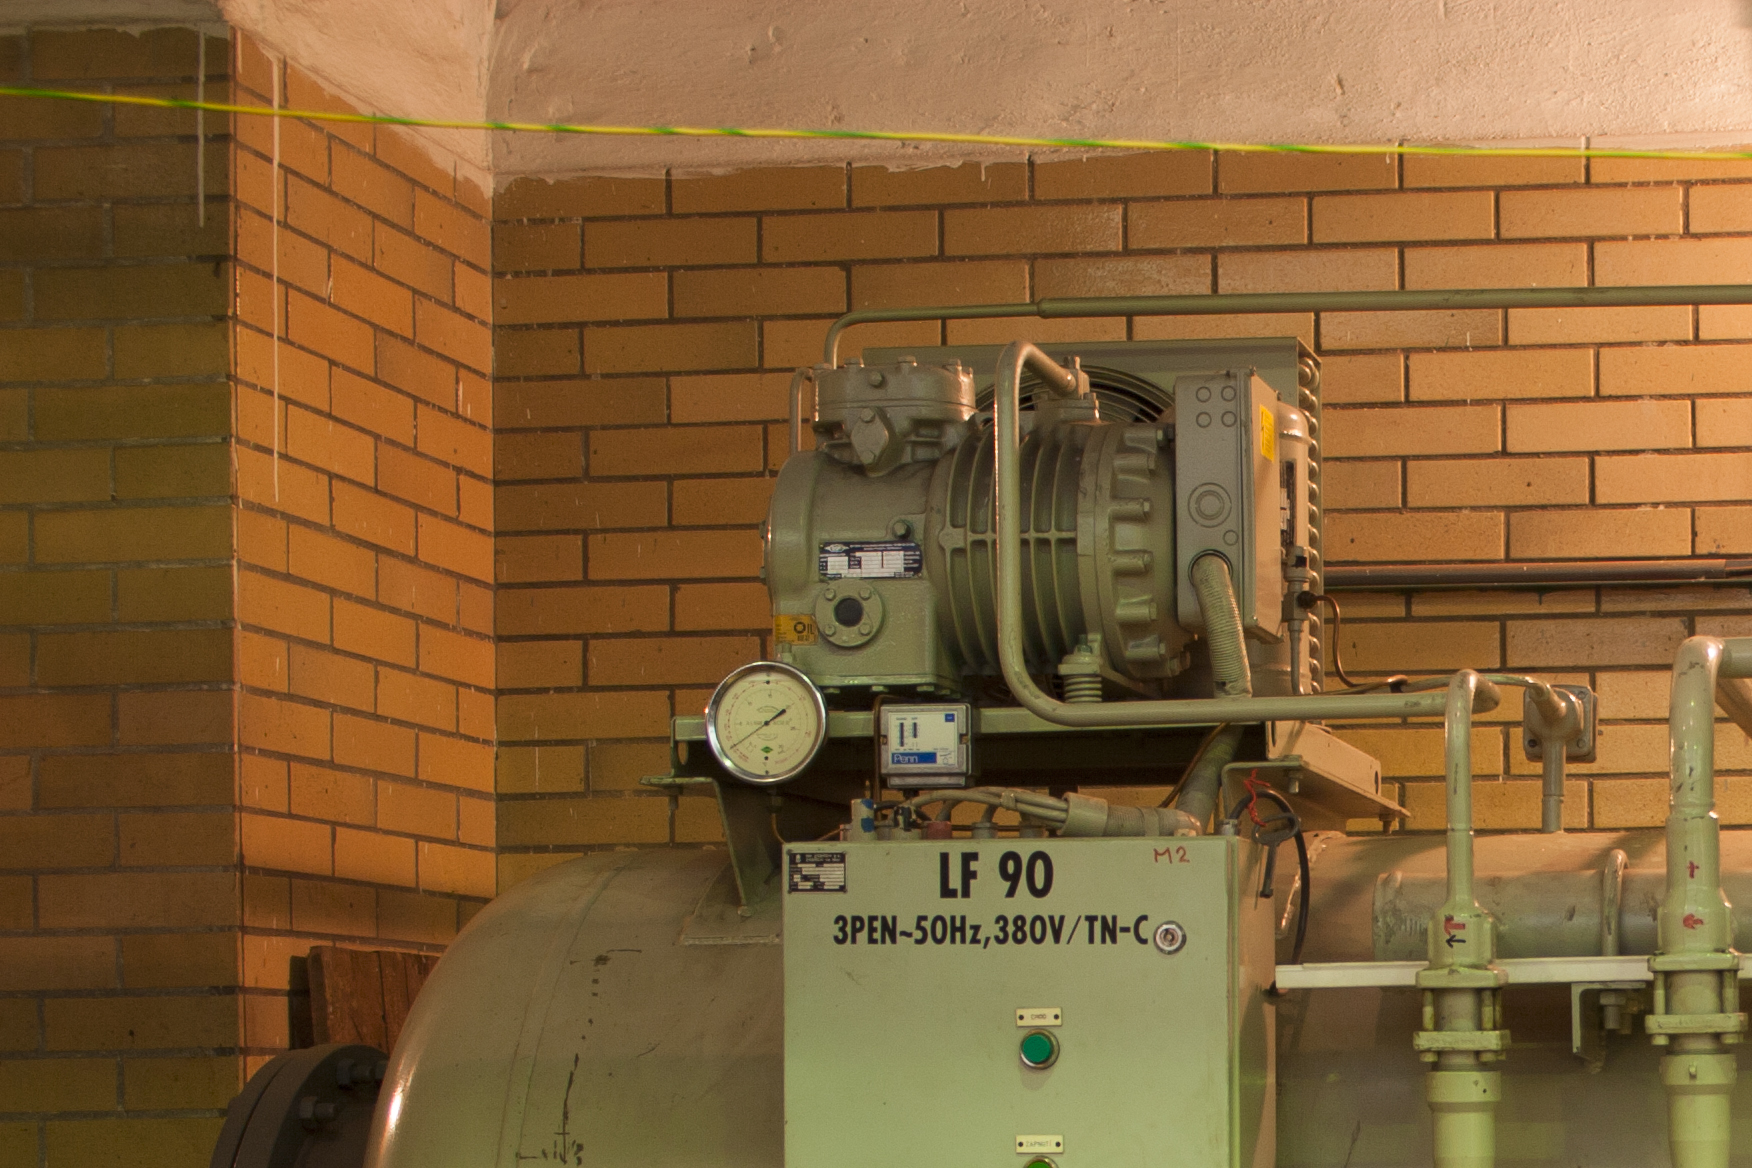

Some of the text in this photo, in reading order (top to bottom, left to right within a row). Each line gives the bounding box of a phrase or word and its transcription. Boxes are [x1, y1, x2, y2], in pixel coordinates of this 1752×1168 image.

[794, 621, 815, 635] OIL
[894, 754, 918, 764] Penn
[939, 851, 1053, 899] LF 90
